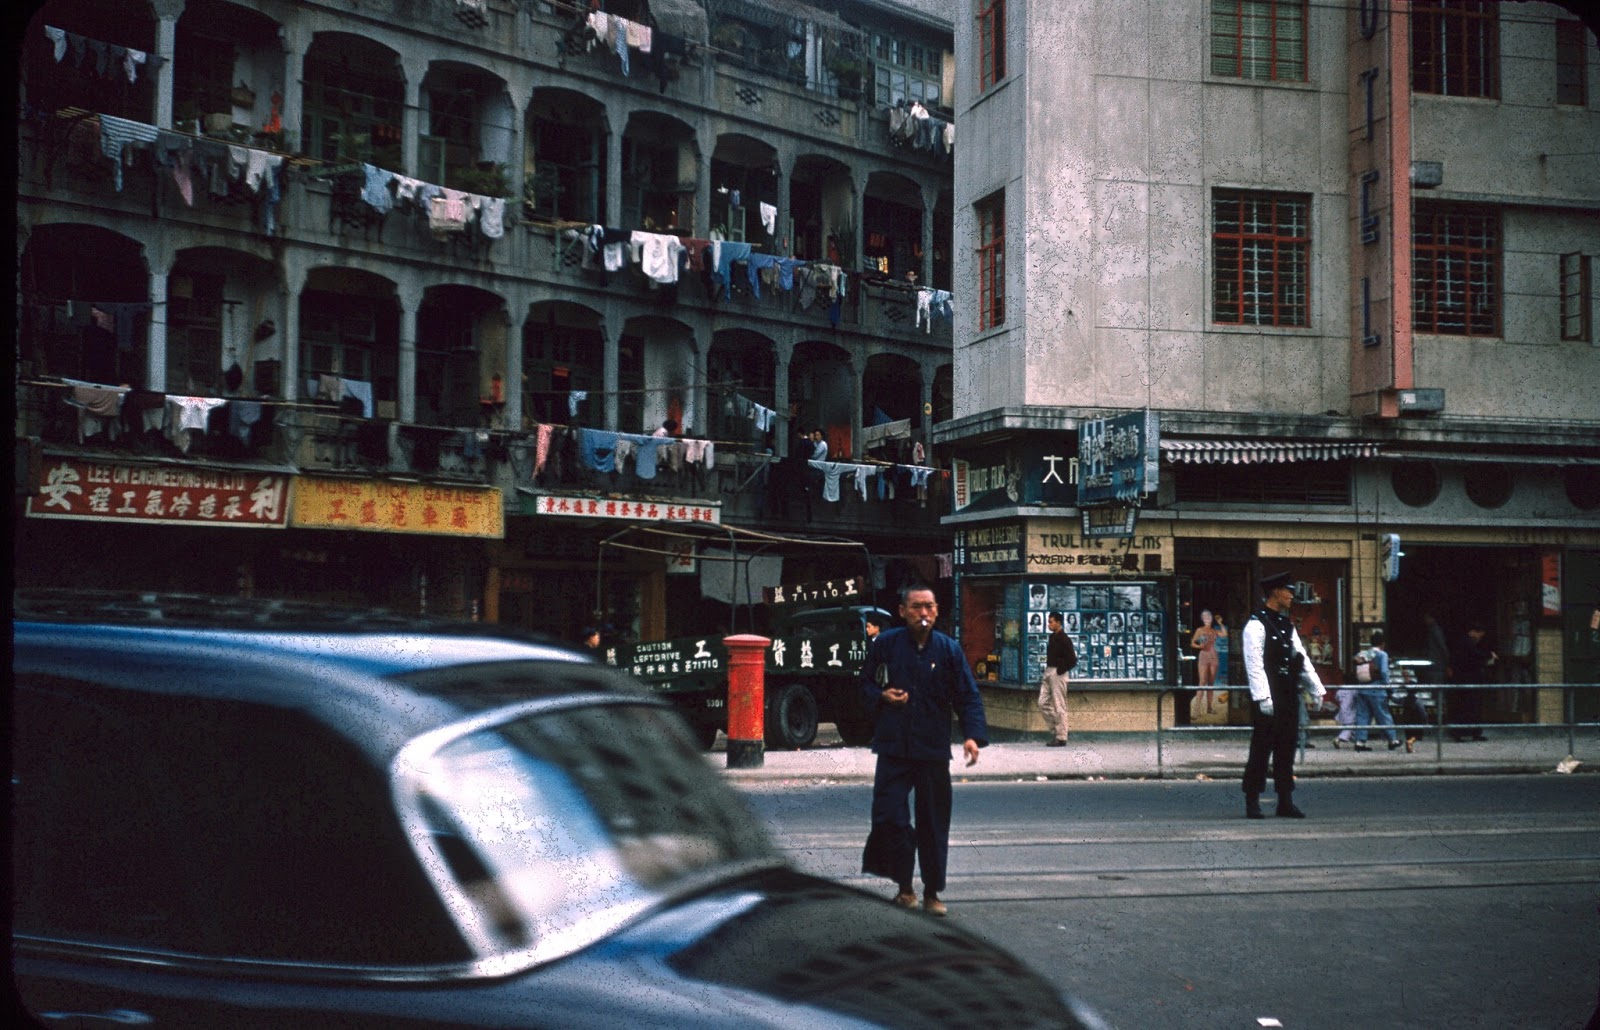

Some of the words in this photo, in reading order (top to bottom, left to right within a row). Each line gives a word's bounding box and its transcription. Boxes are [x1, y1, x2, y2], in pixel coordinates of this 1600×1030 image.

[87, 465, 110, 483] LEE
[792, 588, 838, 602] 71710
[636, 642, 672, 653] CAUTION
